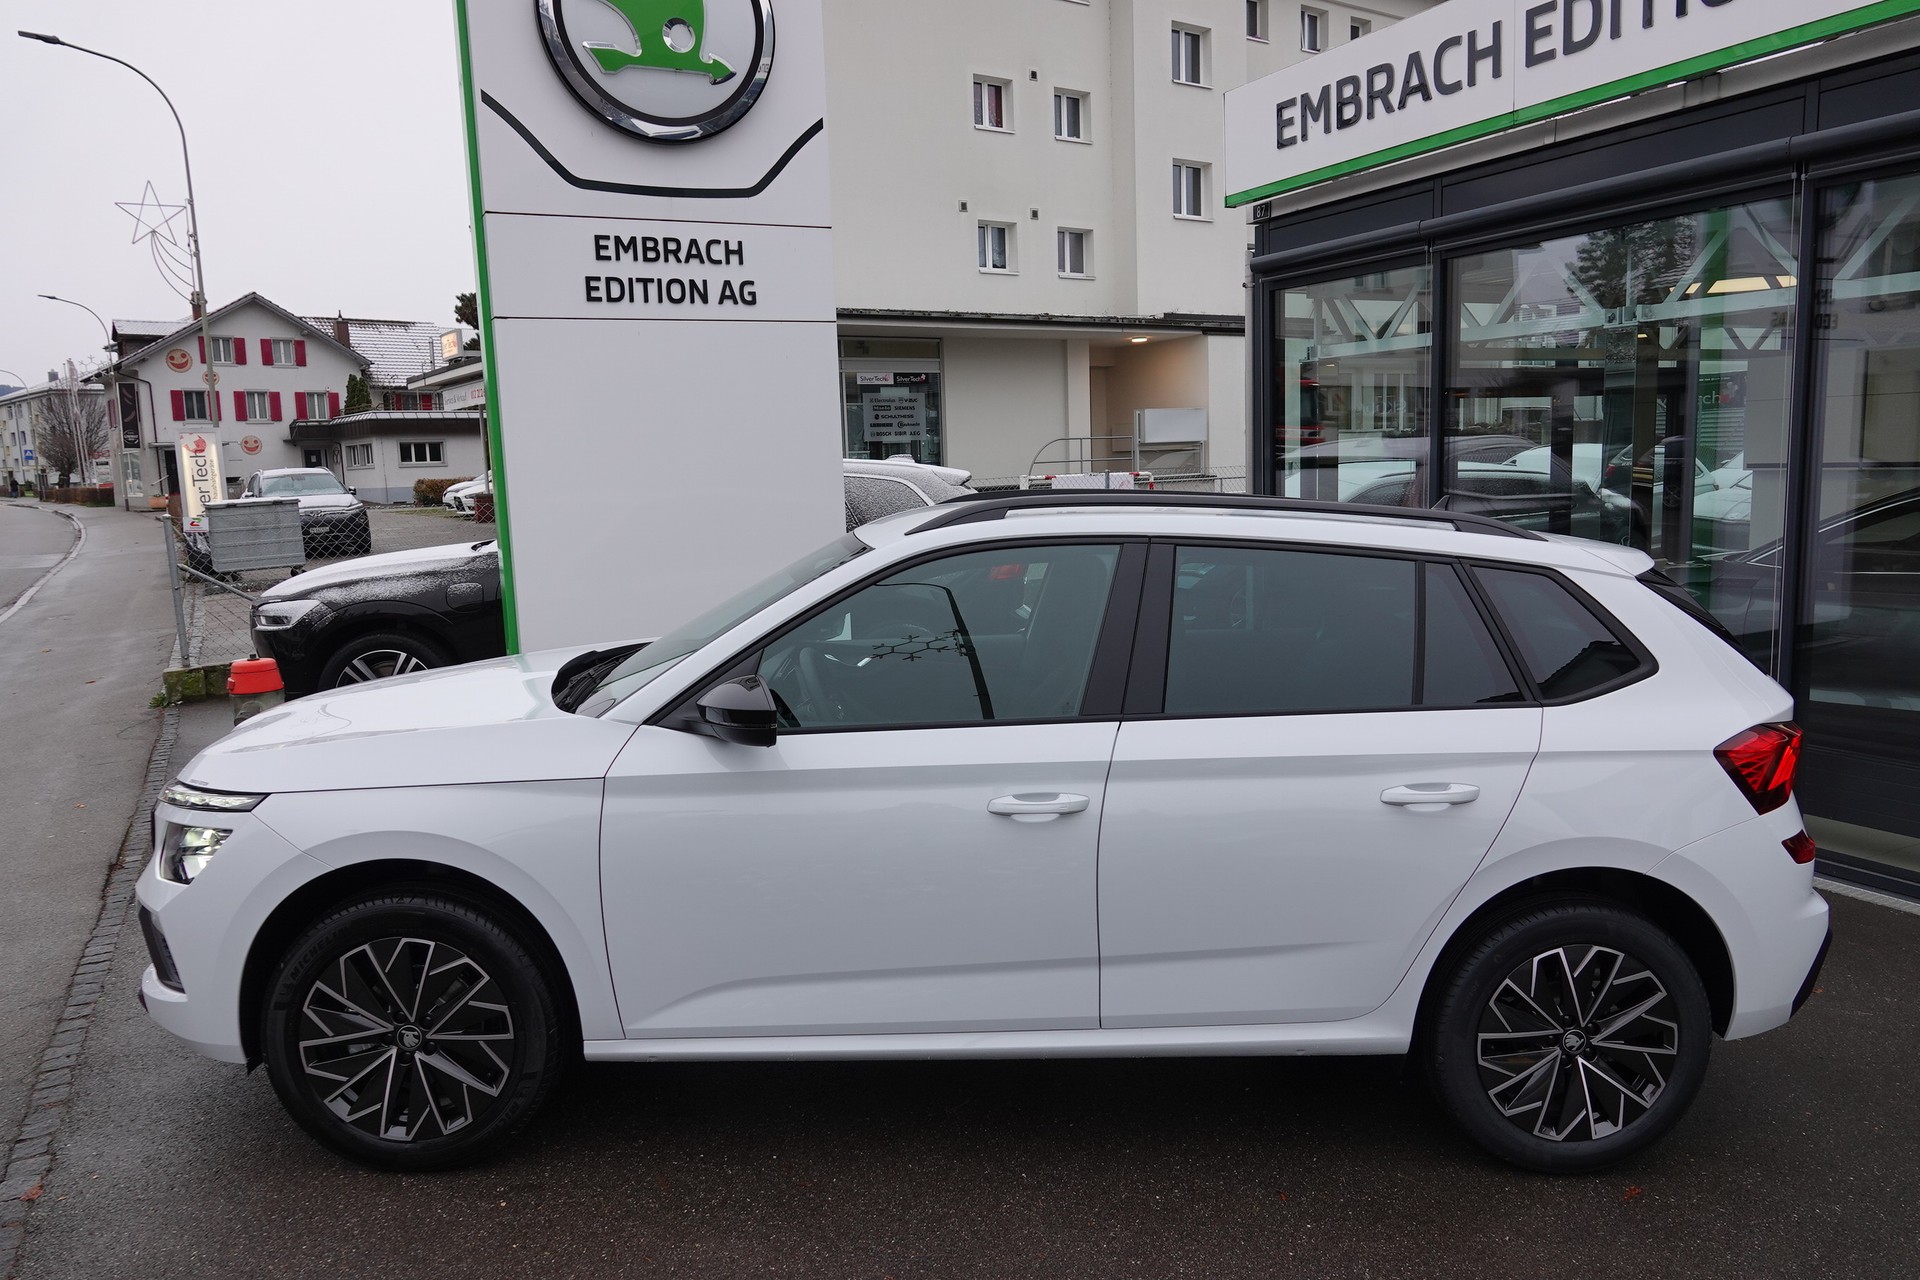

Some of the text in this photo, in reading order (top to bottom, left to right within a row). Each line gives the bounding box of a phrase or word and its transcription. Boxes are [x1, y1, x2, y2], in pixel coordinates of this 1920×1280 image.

[1276, 0, 1733, 150] EMBRACH EDI
[1256, 205, 1265, 218] 87
[594, 234, 744, 265] EMBRACH
[585, 276, 757, 306] EDITION AG
